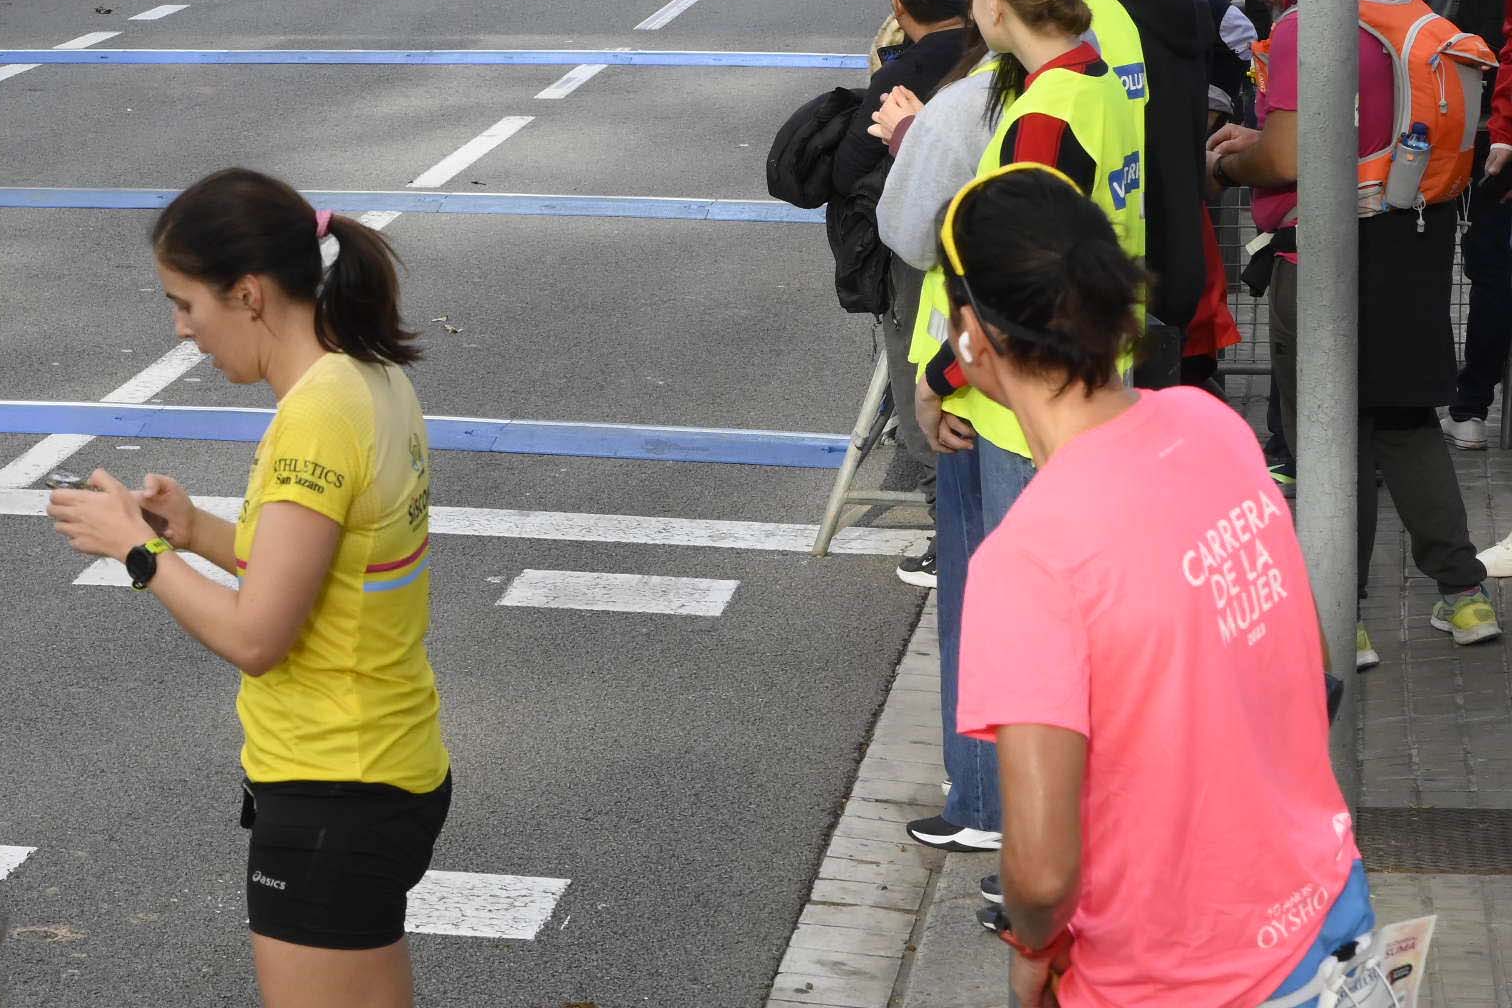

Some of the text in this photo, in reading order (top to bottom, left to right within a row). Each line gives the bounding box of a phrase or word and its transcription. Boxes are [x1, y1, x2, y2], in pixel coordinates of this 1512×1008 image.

[1182, 489, 1282, 587] CARRERA
[1210, 538, 1273, 610] DE LA
[1217, 568, 1288, 644] MUJER
[1256, 886, 1330, 949] OYSHO
